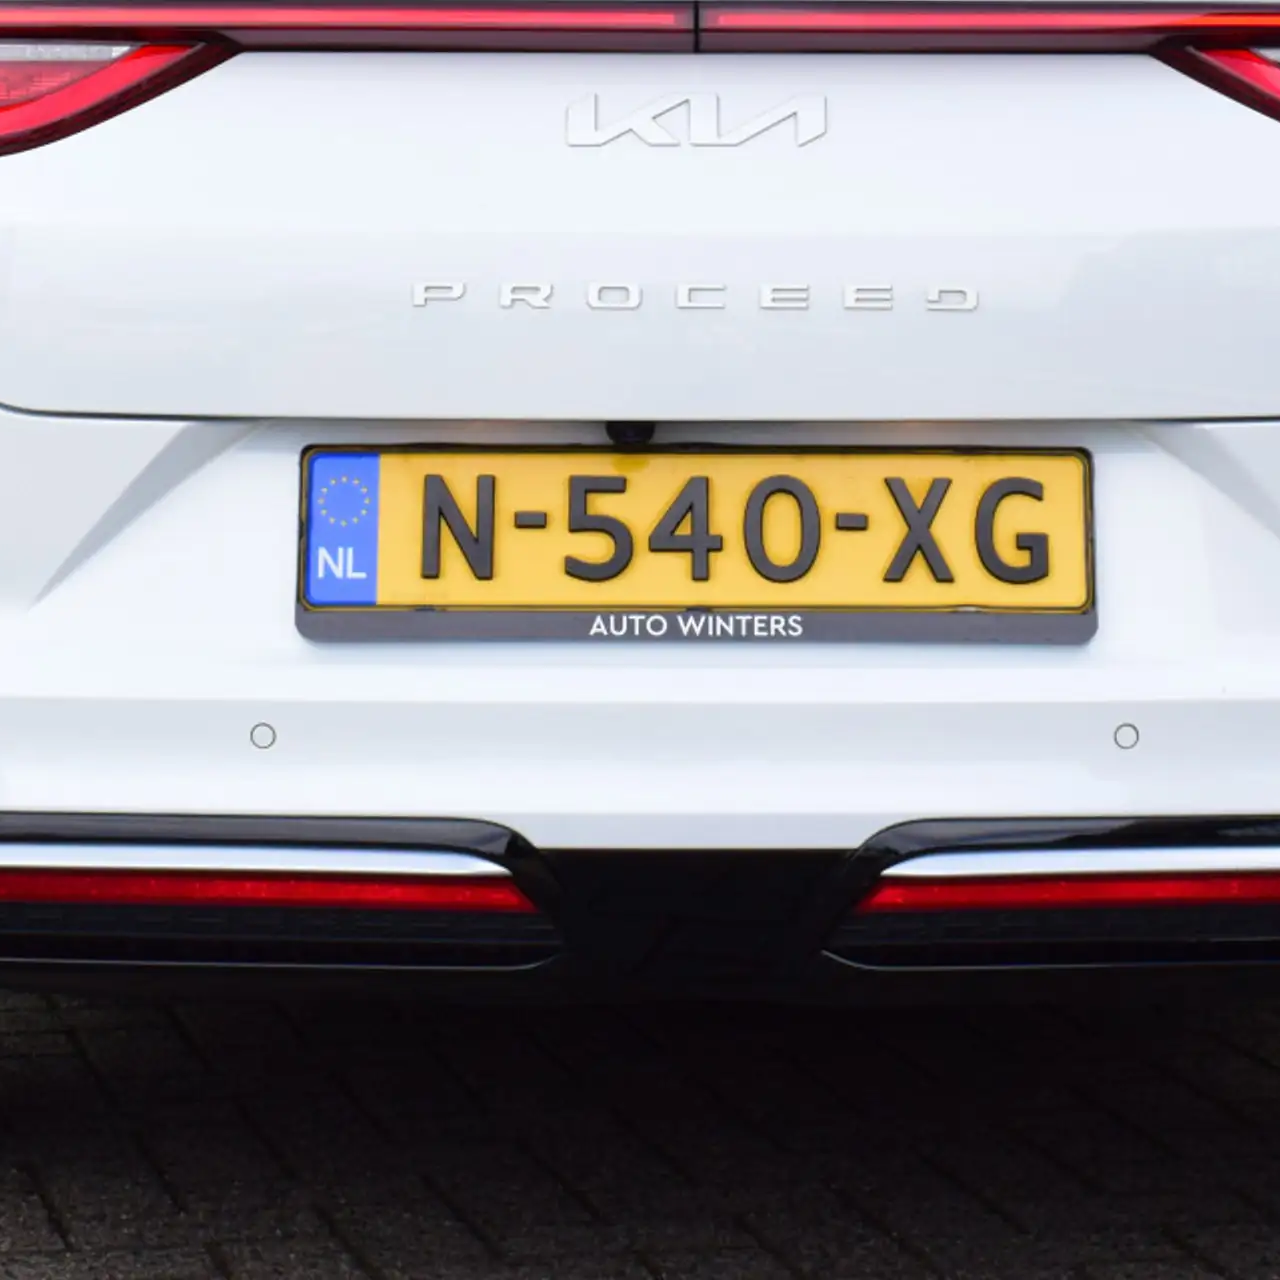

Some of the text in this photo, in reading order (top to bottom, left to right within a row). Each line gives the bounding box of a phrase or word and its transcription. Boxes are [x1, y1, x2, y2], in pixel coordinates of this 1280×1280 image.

[565, 92, 827, 148] KIA
[412, 282, 979, 312] PROCEED
[317, 473, 1050, 585] NL N-540-XG
[589, 614, 804, 638] AUTO WINTERS
